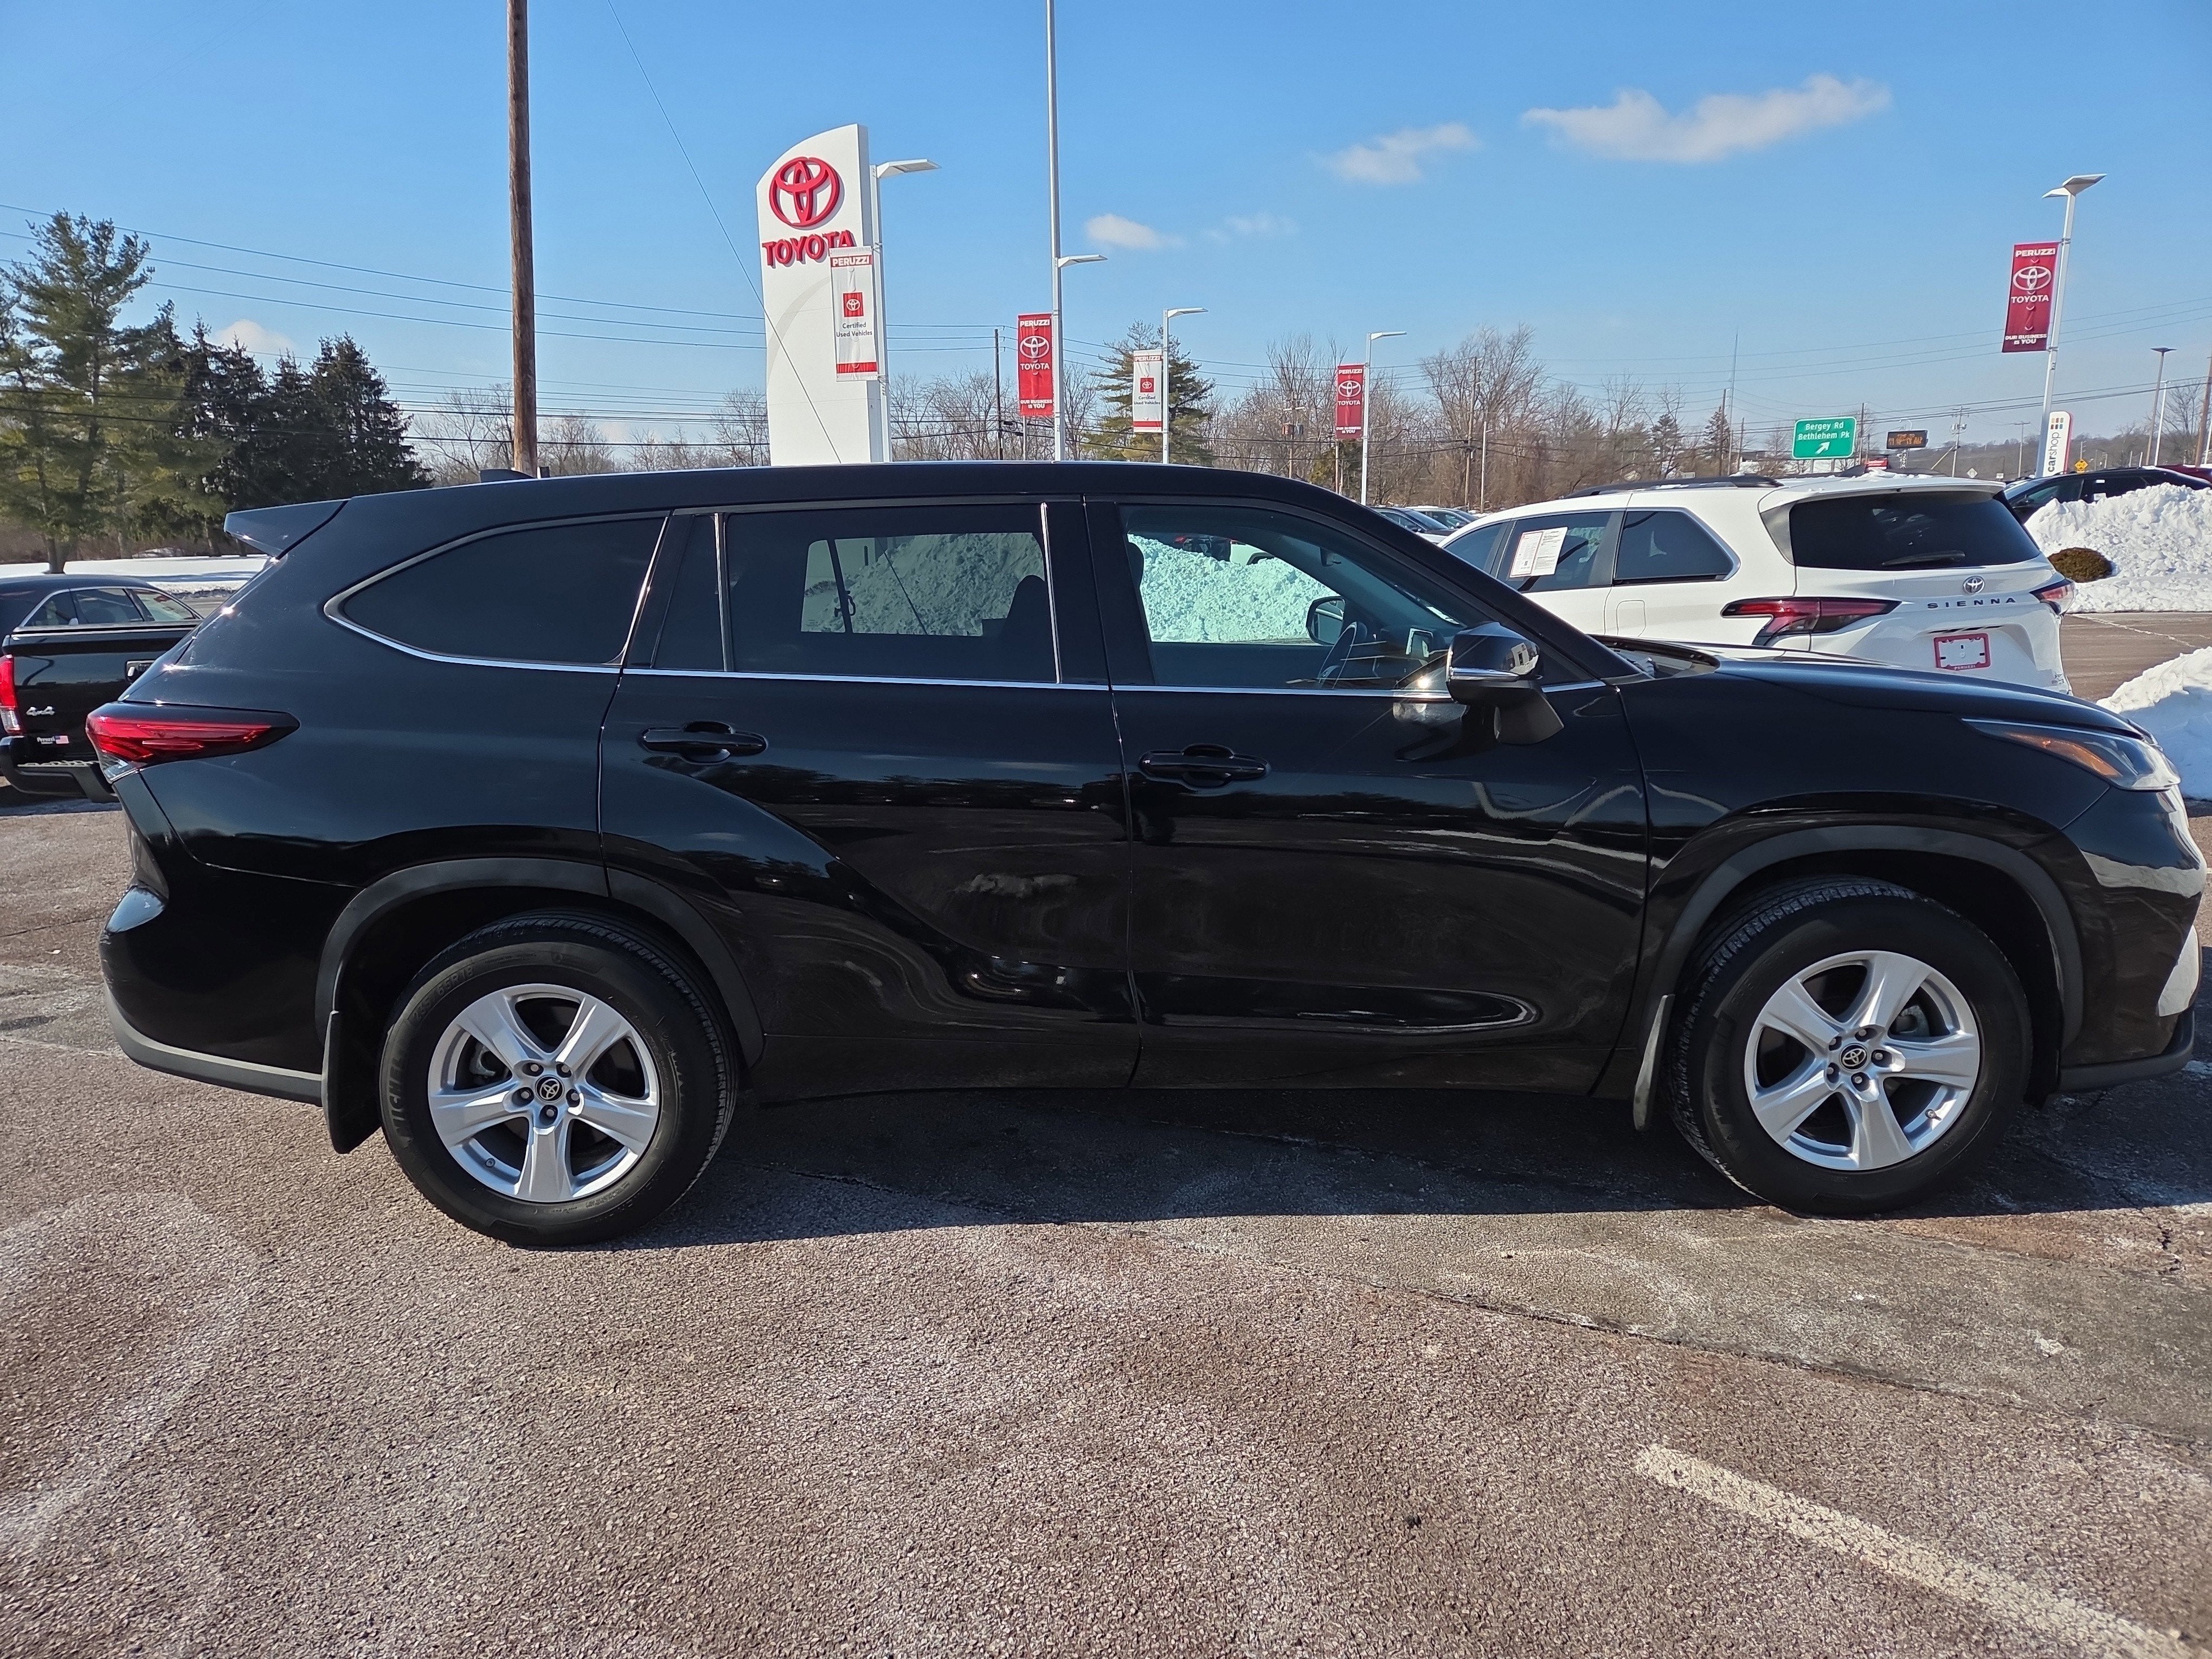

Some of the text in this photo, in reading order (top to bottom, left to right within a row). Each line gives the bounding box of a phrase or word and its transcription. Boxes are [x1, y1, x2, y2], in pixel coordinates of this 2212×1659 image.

[762, 229, 856, 266] TOYOTA
[2015, 248, 2055, 257] PERUZZI
[832, 256, 870, 267] PERUZZI
[2011, 295, 2049, 304] TOYOTA
[1020, 319, 1050, 327] PERUZZI
[1805, 423, 1831, 432] Bergey
[1798, 432, 1837, 440] Bethlehem
[2048, 432, 2061, 472] carshop
[1927, 597, 2016, 609] SIENNA
